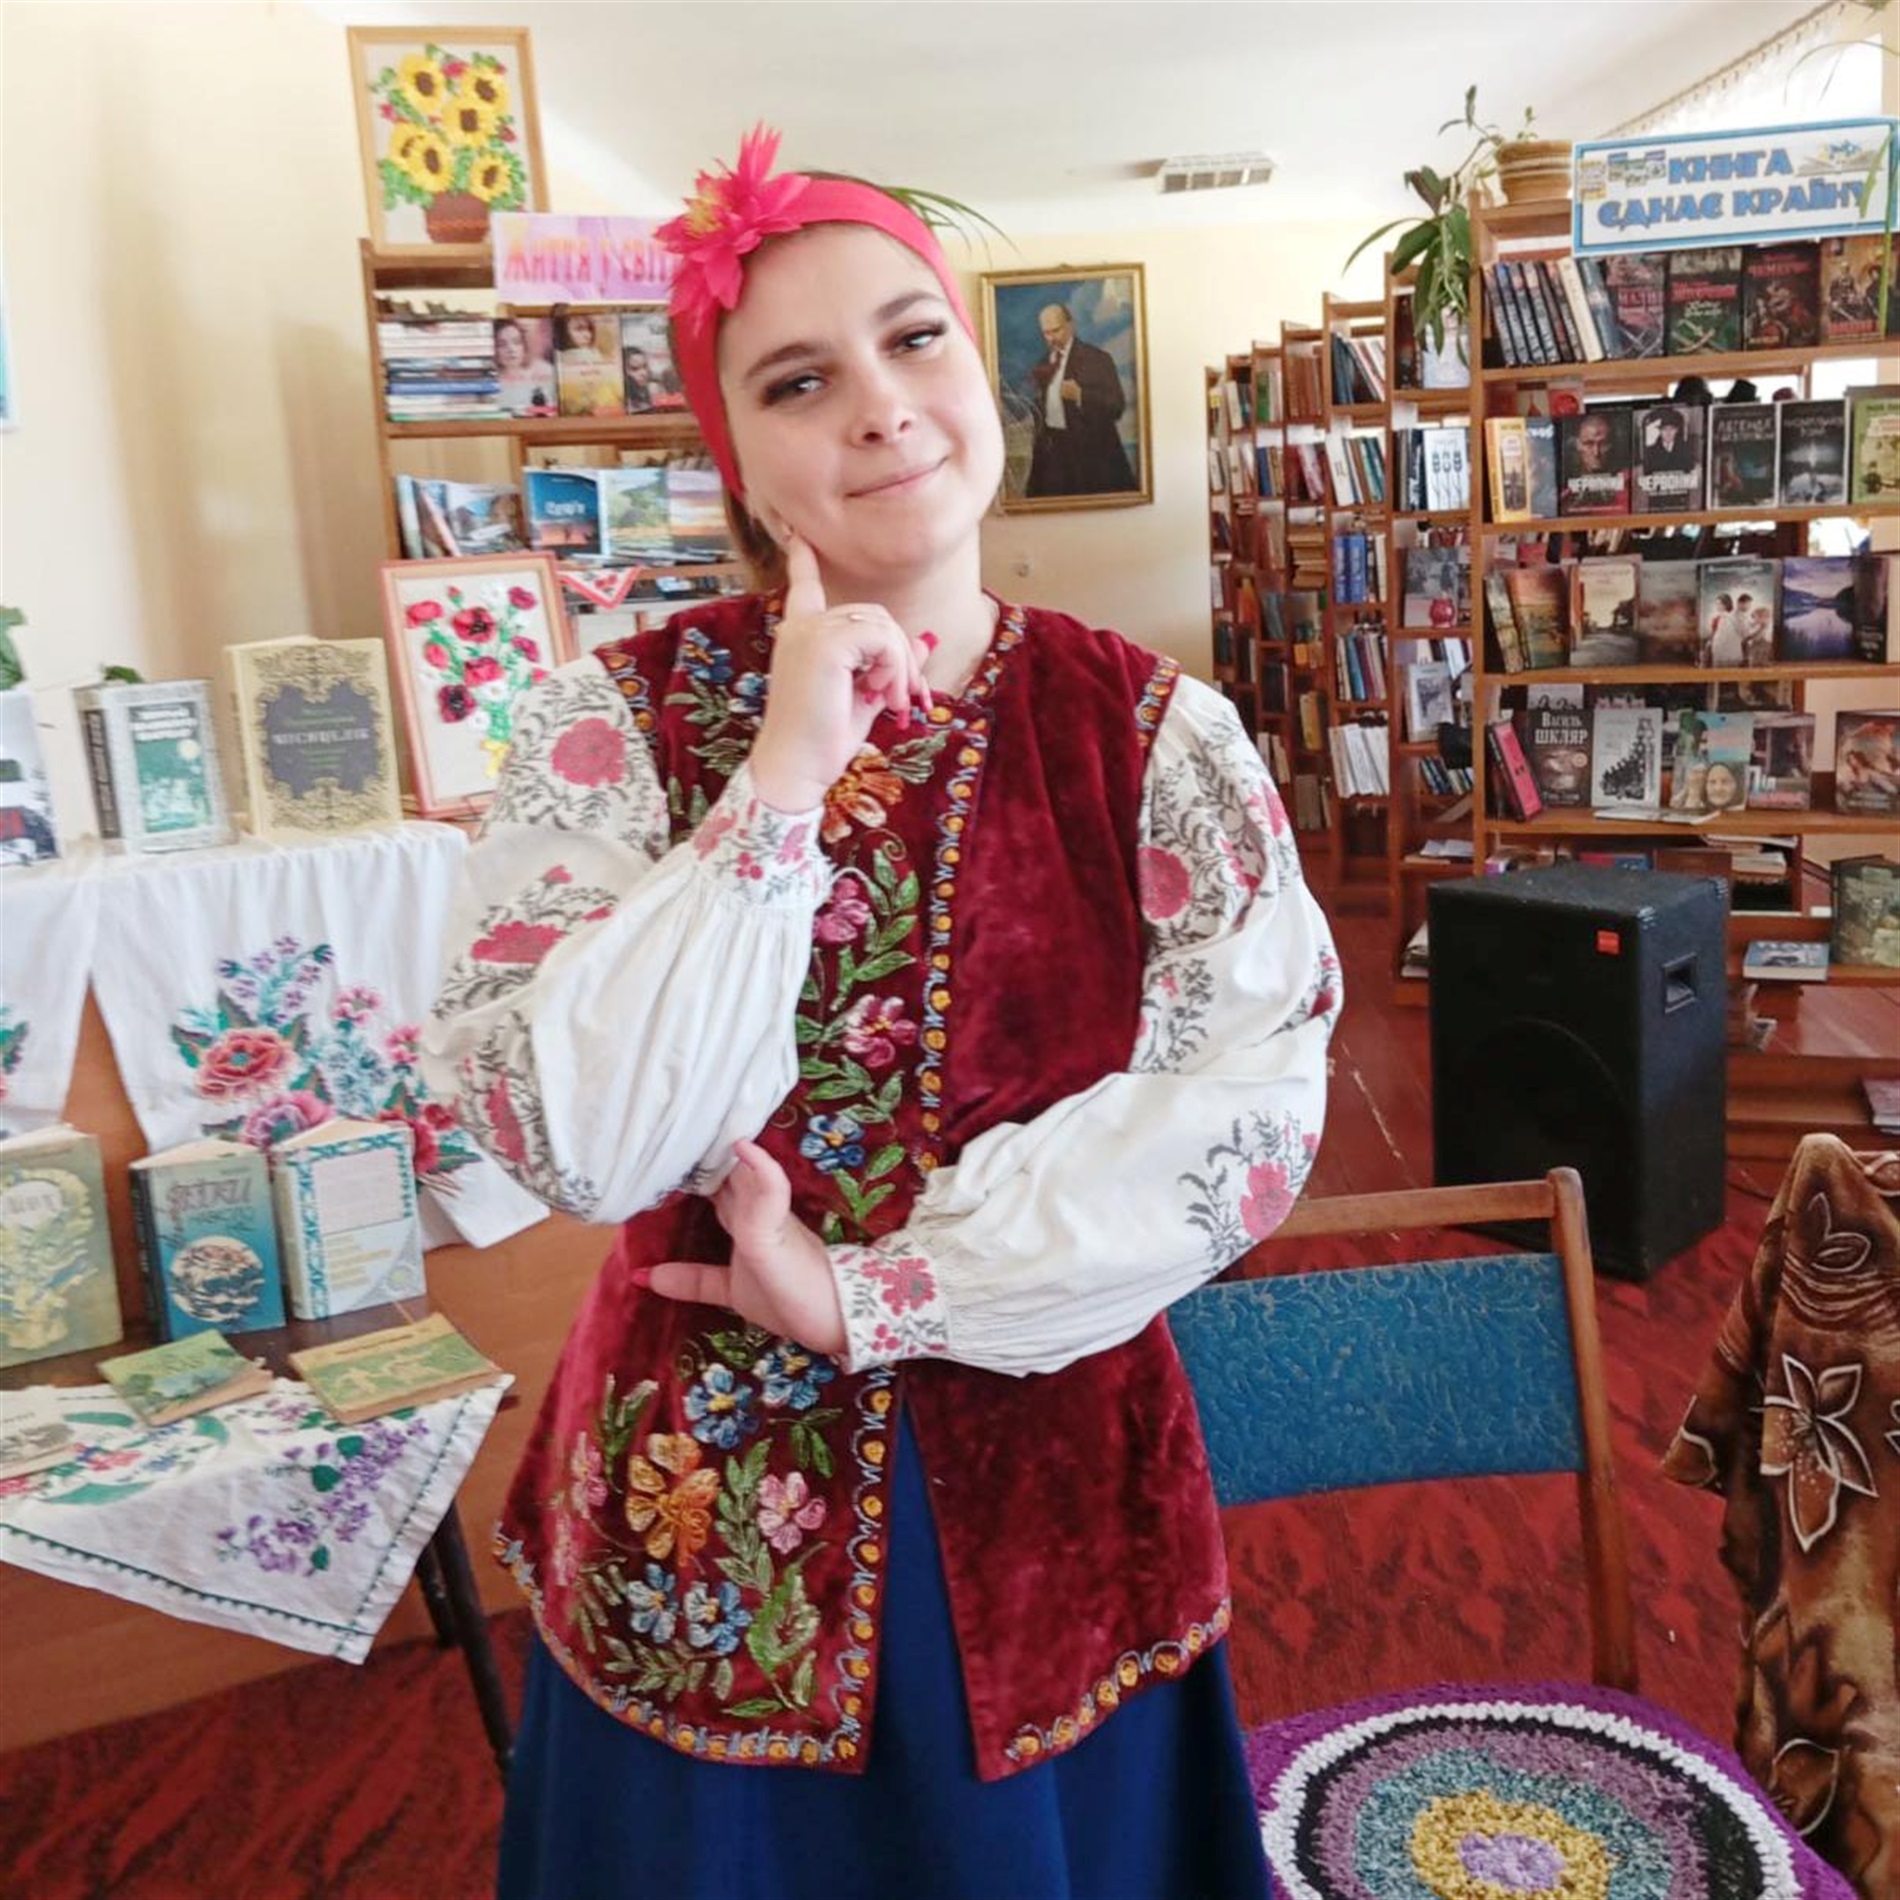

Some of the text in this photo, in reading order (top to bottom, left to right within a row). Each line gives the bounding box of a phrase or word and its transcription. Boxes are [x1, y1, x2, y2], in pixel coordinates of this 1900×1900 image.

[1668, 148, 1794, 184] КНИГА
[1597, 177, 1869, 231] ЄДНАЄ КРАЇНУ
[1637, 473, 1698, 491] ЧЕРВОНИЙ
[1534, 729, 1589, 745] ШКЛЯР
